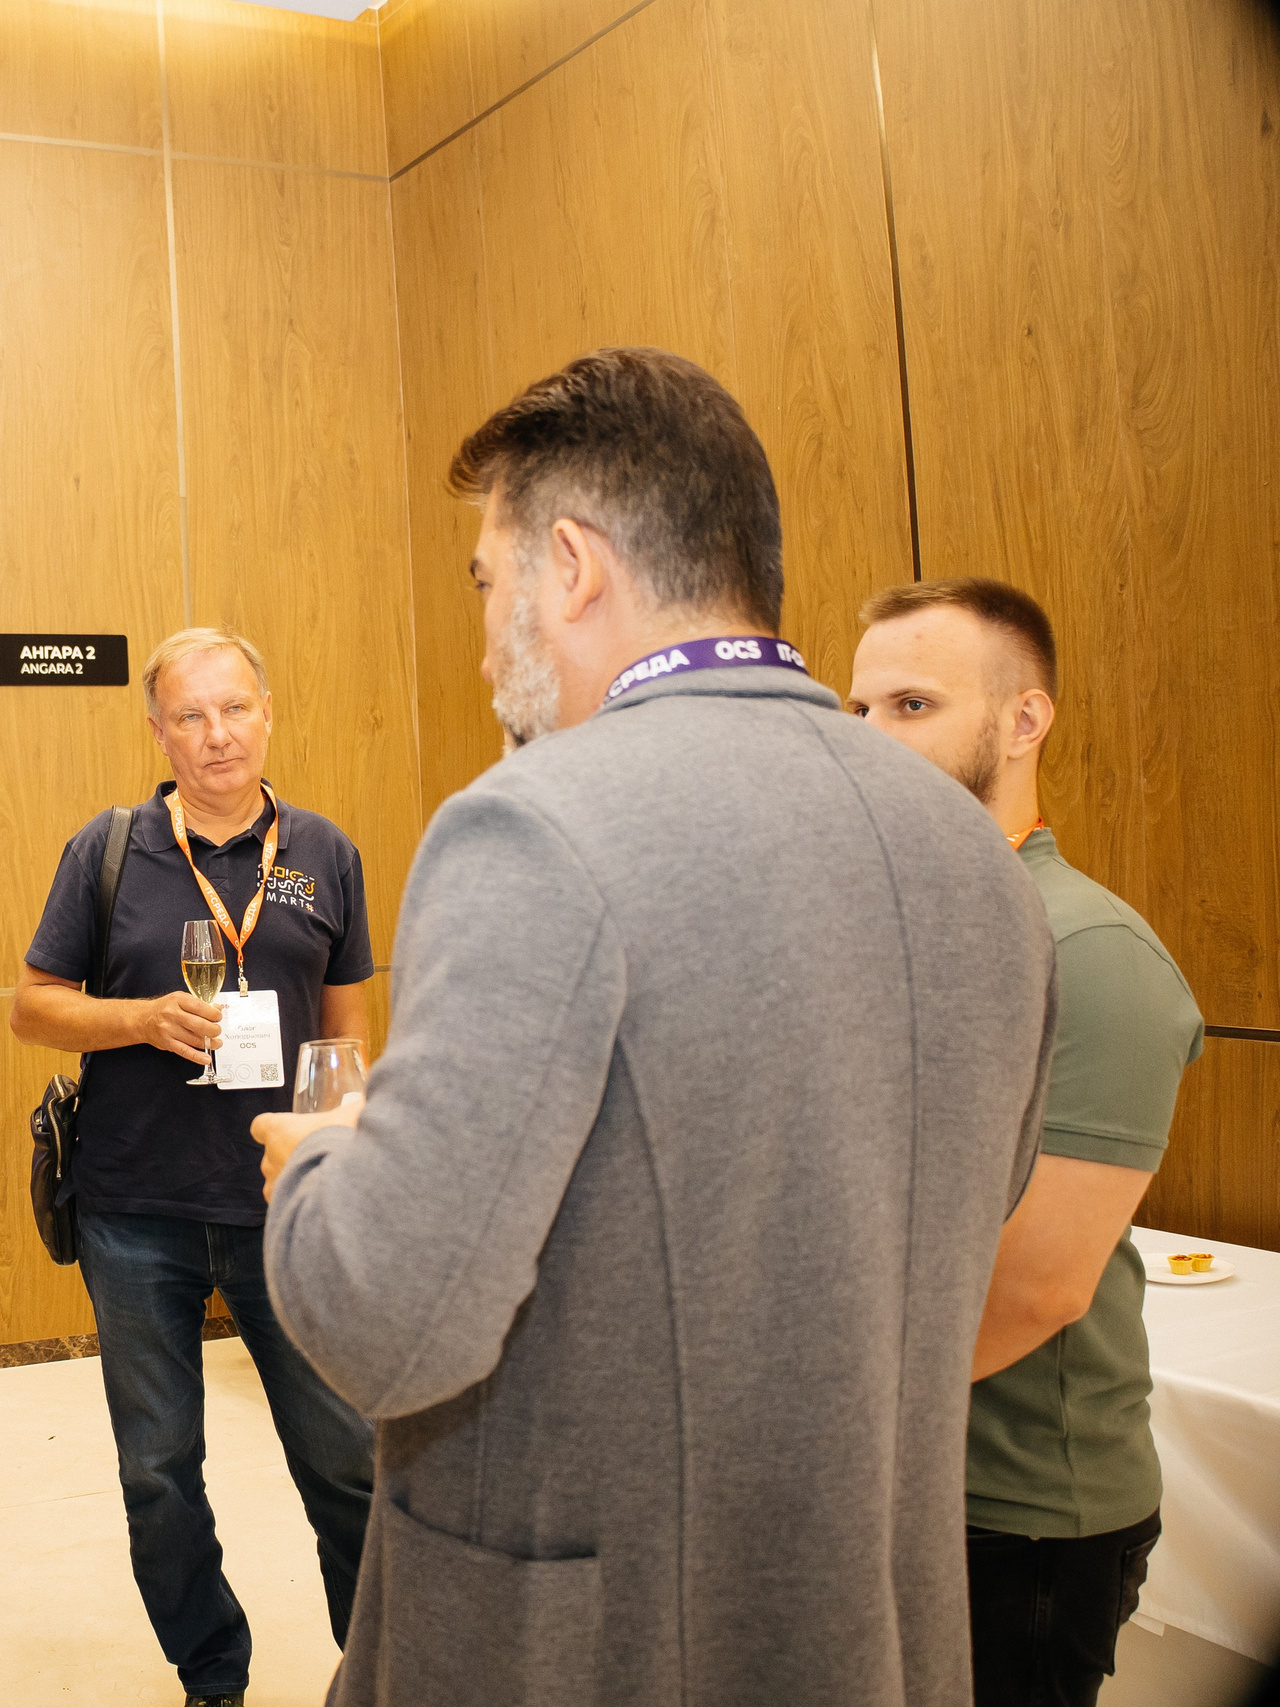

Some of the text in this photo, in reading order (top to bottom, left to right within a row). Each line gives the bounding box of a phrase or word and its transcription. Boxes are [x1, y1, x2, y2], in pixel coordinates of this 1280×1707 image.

[20, 645, 96, 660] АНГАРА 2
[714, 640, 762, 660] OCS
[20, 663, 83, 675] ANGARA 2
[607, 649, 691, 698] СРЕДА
[204, 886, 230, 928] IT-СРЕДА
